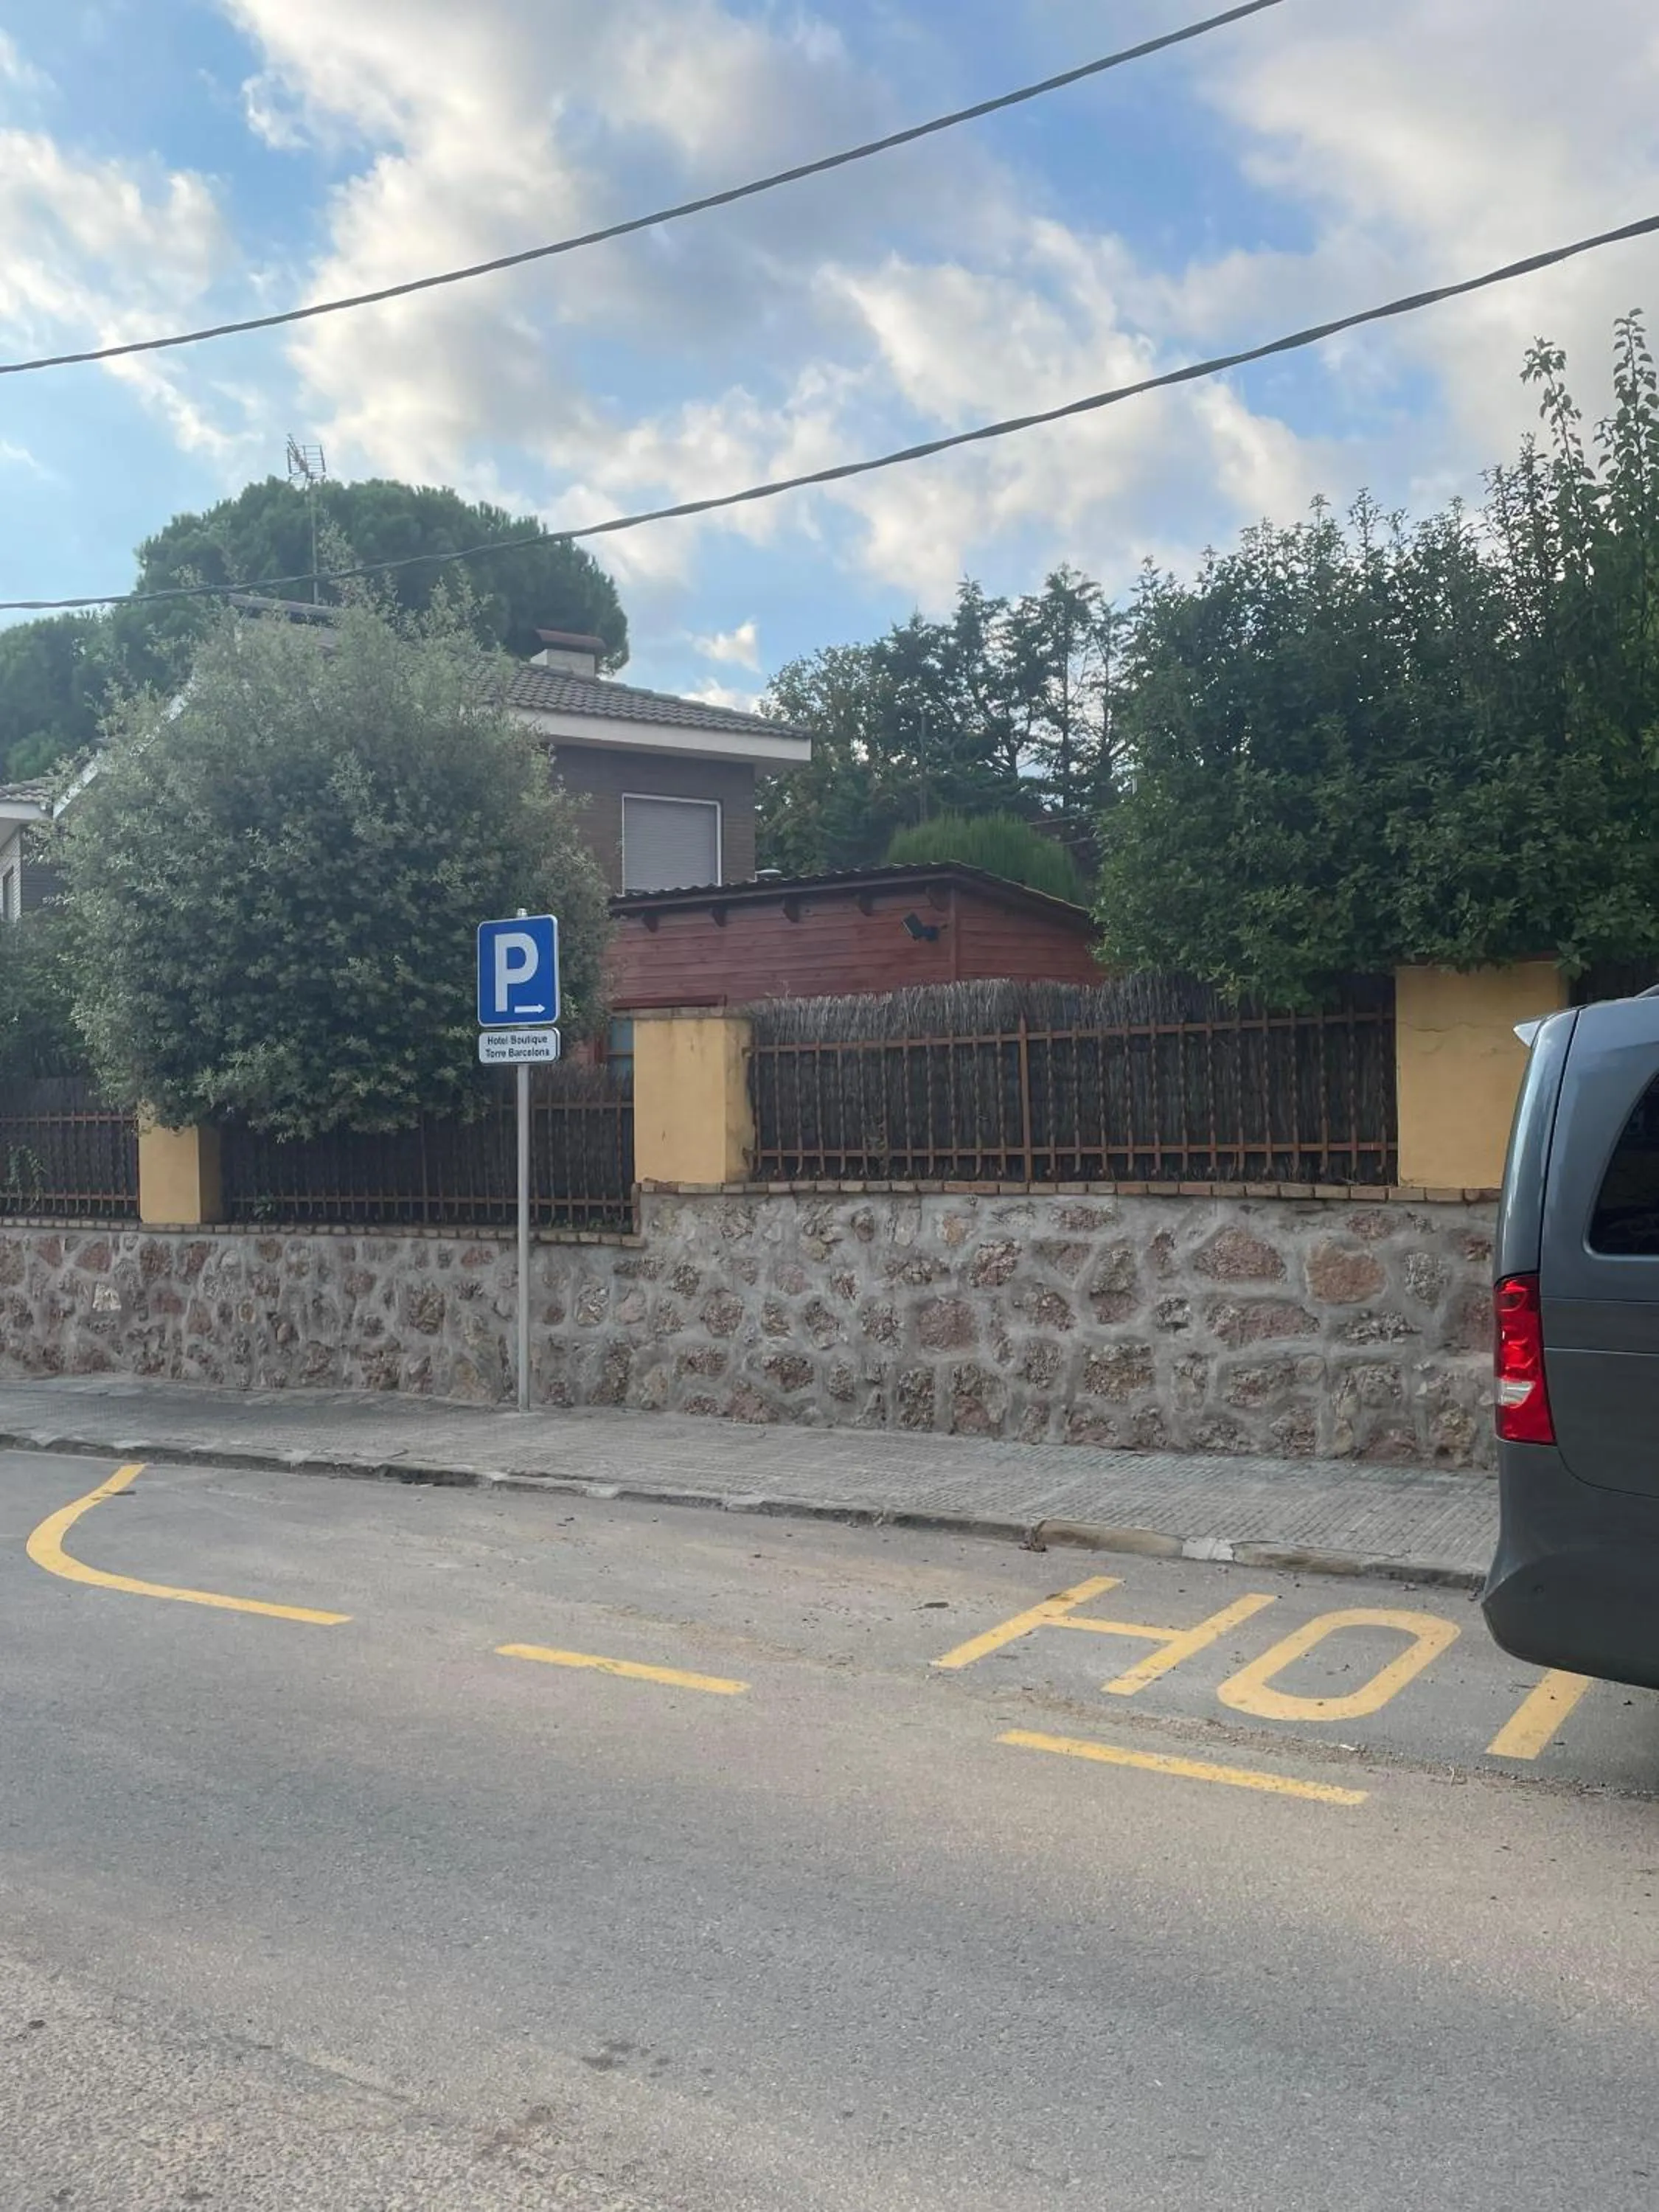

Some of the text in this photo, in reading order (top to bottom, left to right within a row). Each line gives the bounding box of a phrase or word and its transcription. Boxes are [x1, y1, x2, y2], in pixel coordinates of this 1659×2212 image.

[495, 933, 538, 1012] P
[487, 1034, 548, 1046] Hotel Boutique
[485, 1047, 549, 1058] Torre Barcelona
